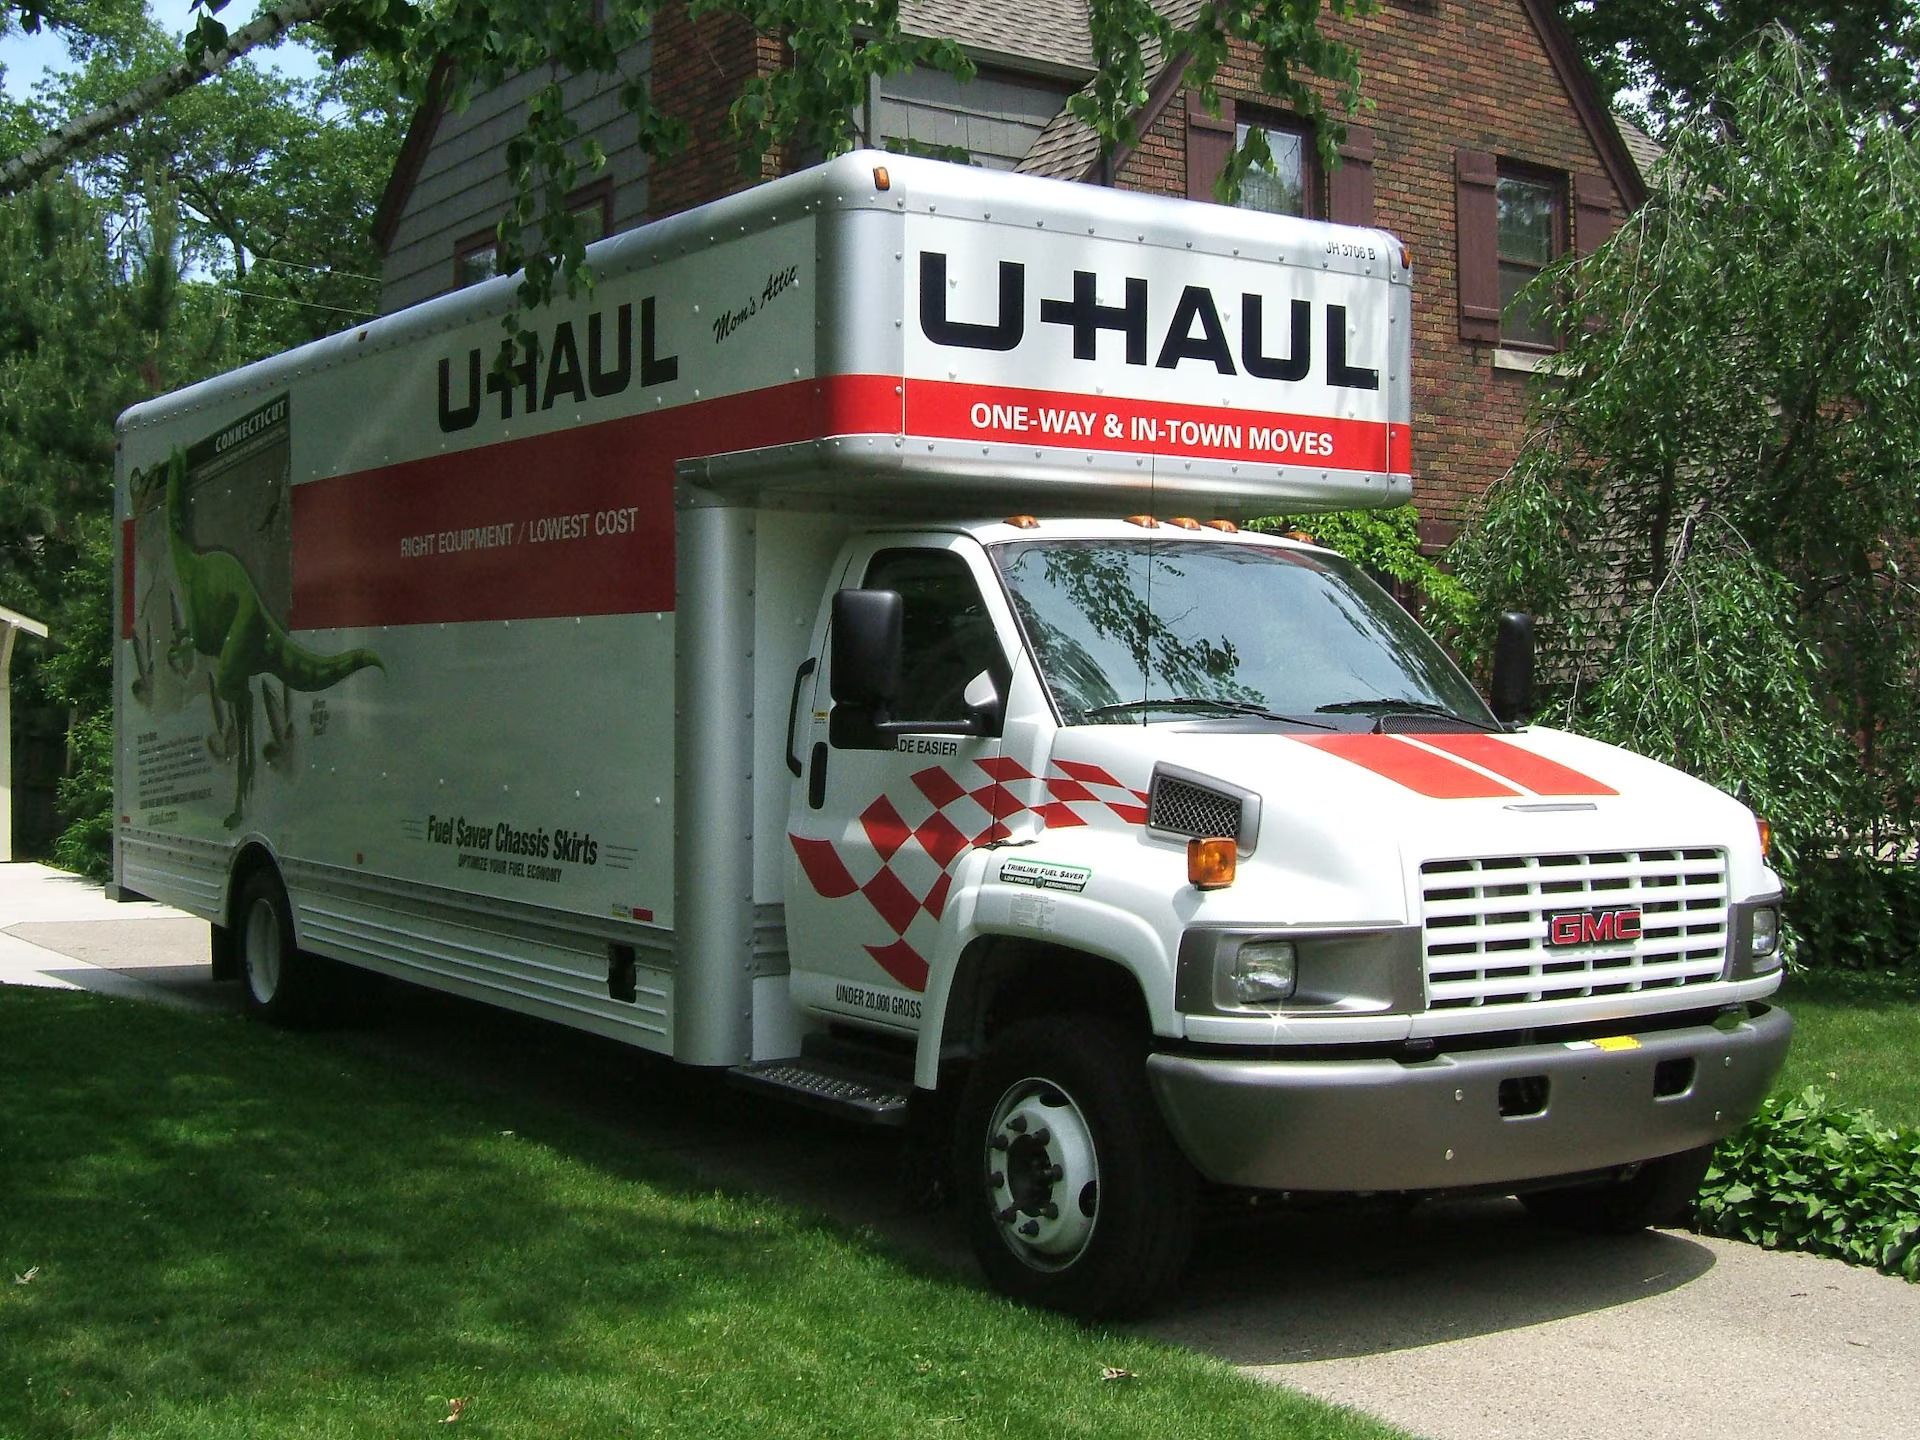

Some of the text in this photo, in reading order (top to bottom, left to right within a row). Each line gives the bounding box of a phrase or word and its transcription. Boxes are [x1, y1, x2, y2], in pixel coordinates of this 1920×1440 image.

[1326, 241, 1376, 261] JH 3706 B
[712, 264, 799, 344] Mom's Attic
[920, 251, 1379, 391] U-HAUL
[438, 296, 678, 433] U-HAUL
[215, 399, 286, 453] CONNECTICUT
[970, 402, 1334, 456] ONE-WAY & IN-TOWN MOVES
[400, 533, 435, 558] RIGHT
[439, 523, 514, 554] EQUIPMENT
[529, 513, 590, 543] LOWEST
[595, 507, 639, 535] COST
[891, 739, 958, 757] ADE EASIER
[427, 815, 454, 845] Fuel
[495, 822, 550, 859] Chassis
[552, 829, 598, 866] Skirts
[489, 858, 507, 875] YOUR
[508, 861, 525, 878] FUEL
[527, 864, 562, 883] ECONOMY
[1551, 910, 1641, 946] GMC
[836, 983, 922, 1019] UNDER 20,000 GROSS
